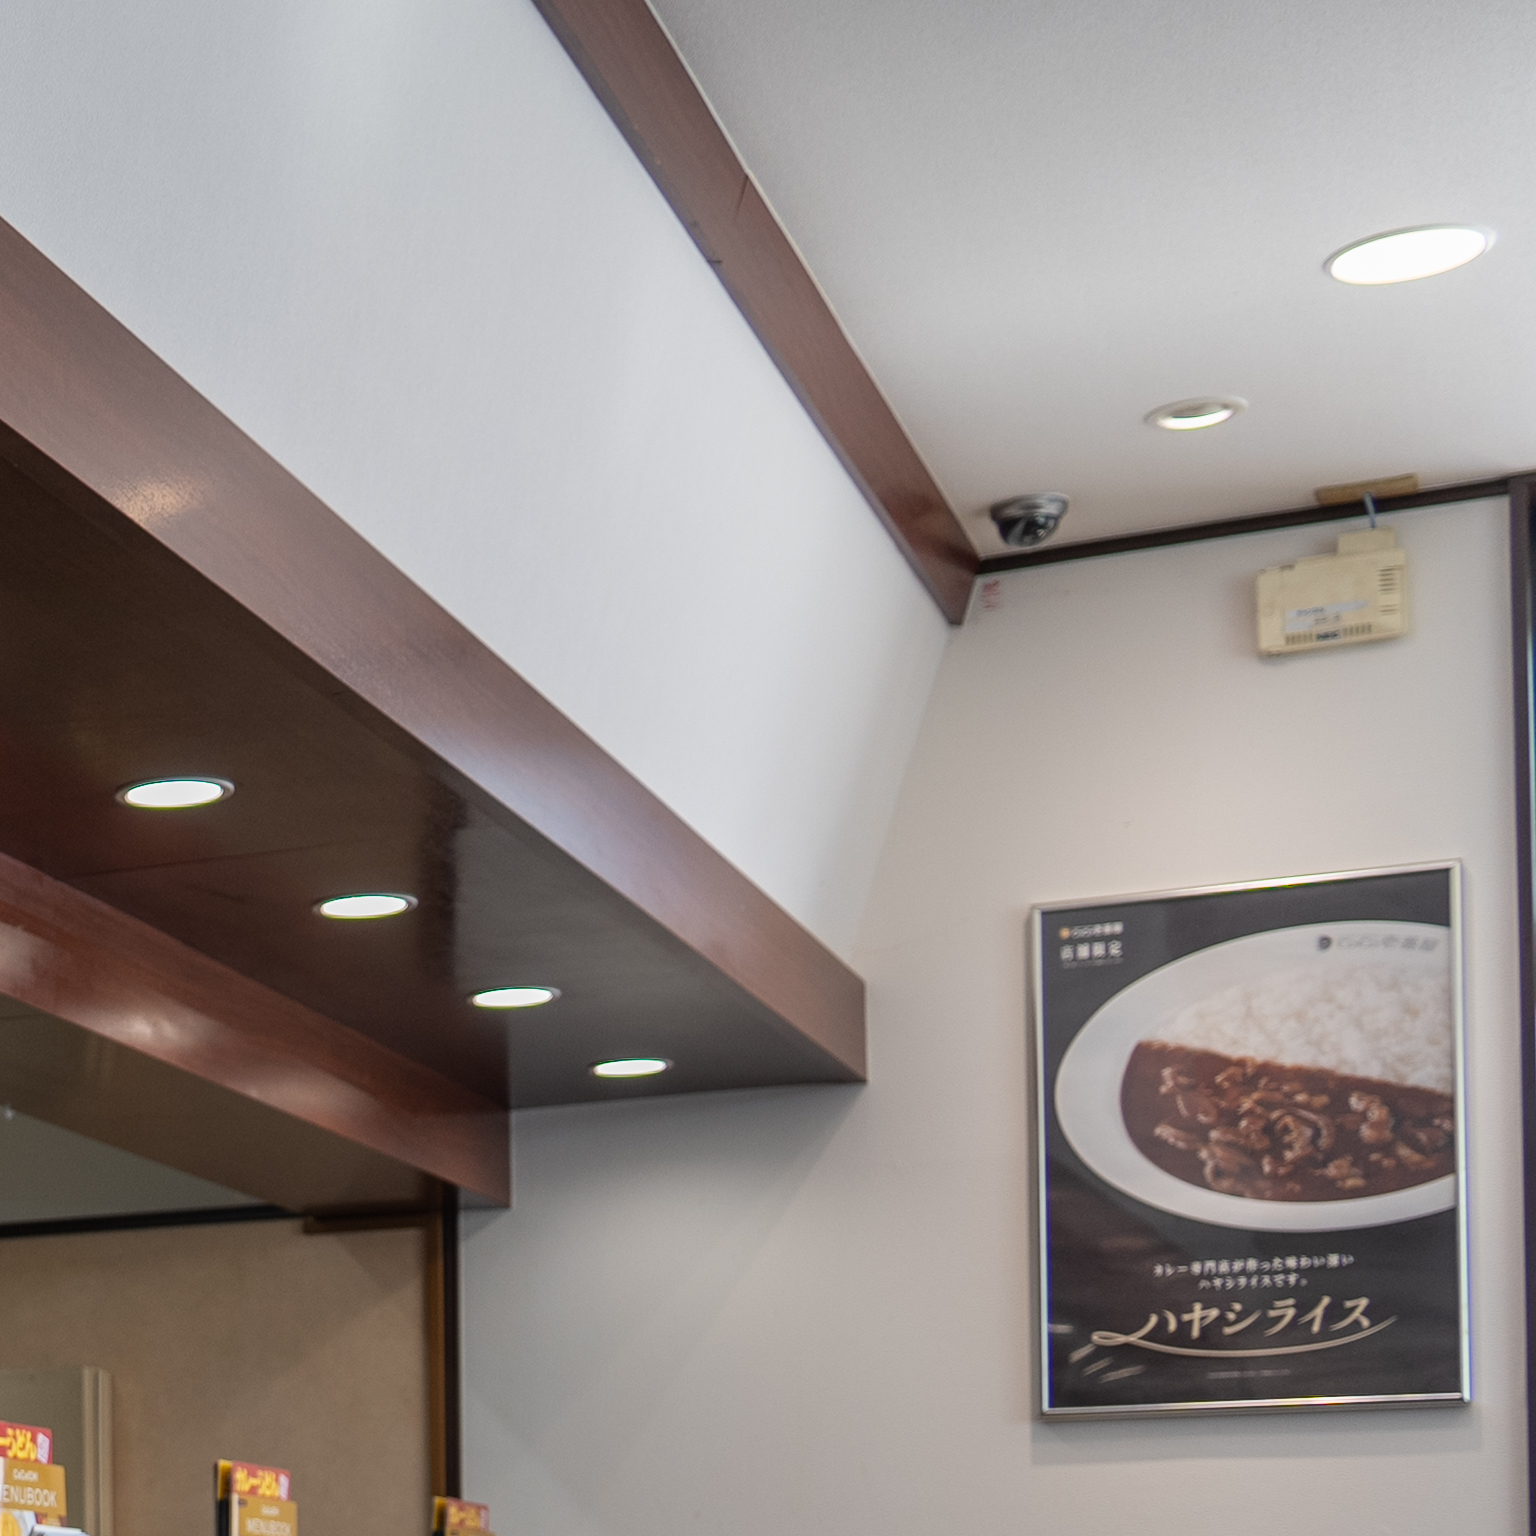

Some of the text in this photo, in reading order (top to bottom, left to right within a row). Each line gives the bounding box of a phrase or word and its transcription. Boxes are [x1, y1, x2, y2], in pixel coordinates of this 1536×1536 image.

[1136, 1295, 1371, 1340] ハヤシライス
